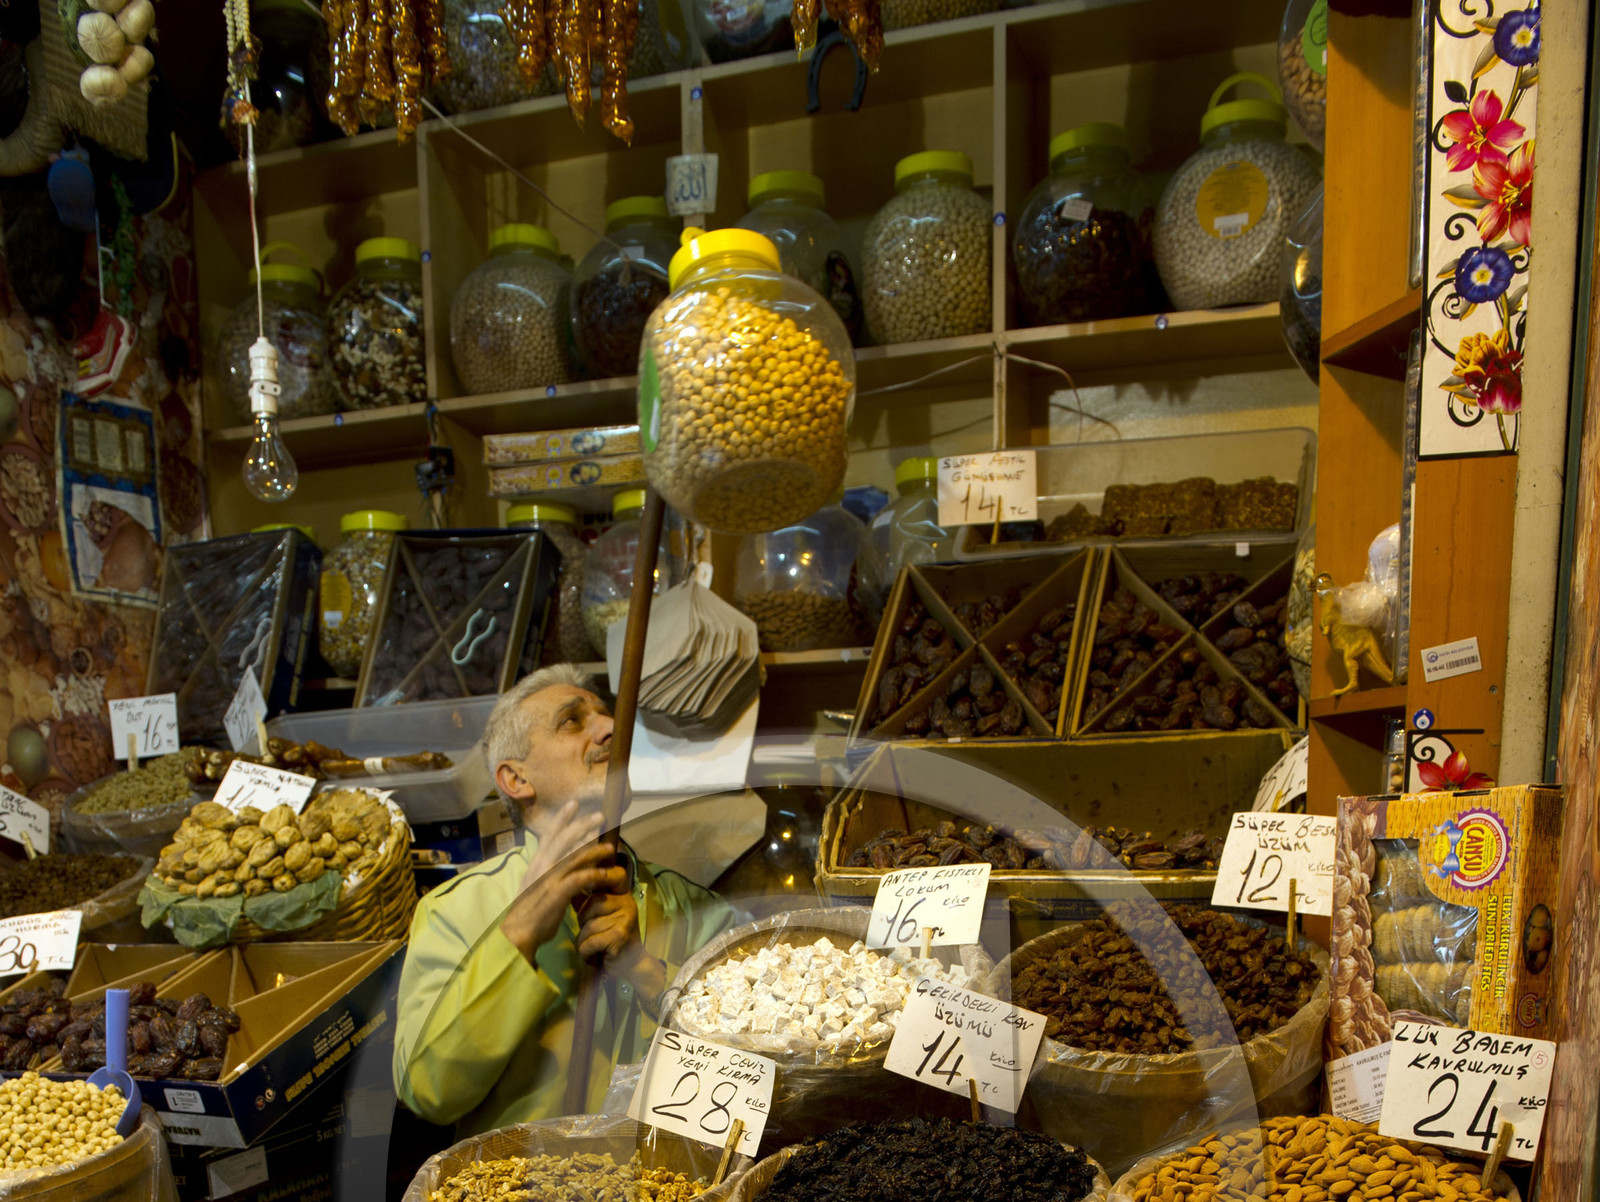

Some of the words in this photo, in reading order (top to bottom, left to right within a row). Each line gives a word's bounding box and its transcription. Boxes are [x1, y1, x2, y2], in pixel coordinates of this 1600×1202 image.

[142, 714, 163, 752] 16
[1257, 833, 1311, 853] ÜZÜM
[1464, 826, 1485, 872] CANSU
[882, 870, 928, 888] ANTEP
[895, 883, 950, 897] LOKUM
[1236, 849, 1284, 904] 12
[1486, 895, 1498, 921] SUN
[1501, 895, 1513, 921] LUX
[1483, 925, 1497, 963] DRIED
[1498, 924, 1511, 961] KURU
[1480, 965, 1494, 992] FIGS
[658, 1032, 720, 1060] SÜPER
[729, 1053, 767, 1075] CEVİZ
[1395, 1024, 1440, 1047] LÜX
[1451, 1030, 1534, 1057] BADEM
[677, 1055, 711, 1072] YENİ
[716, 1065, 762, 1086] KIRMA
[1407, 1052, 1530, 1080] KAVRULMUŞ
[651, 1071, 739, 1135] 28
[1412, 1072, 1499, 1152] 24
[1515, 1138, 1535, 1149] TL
